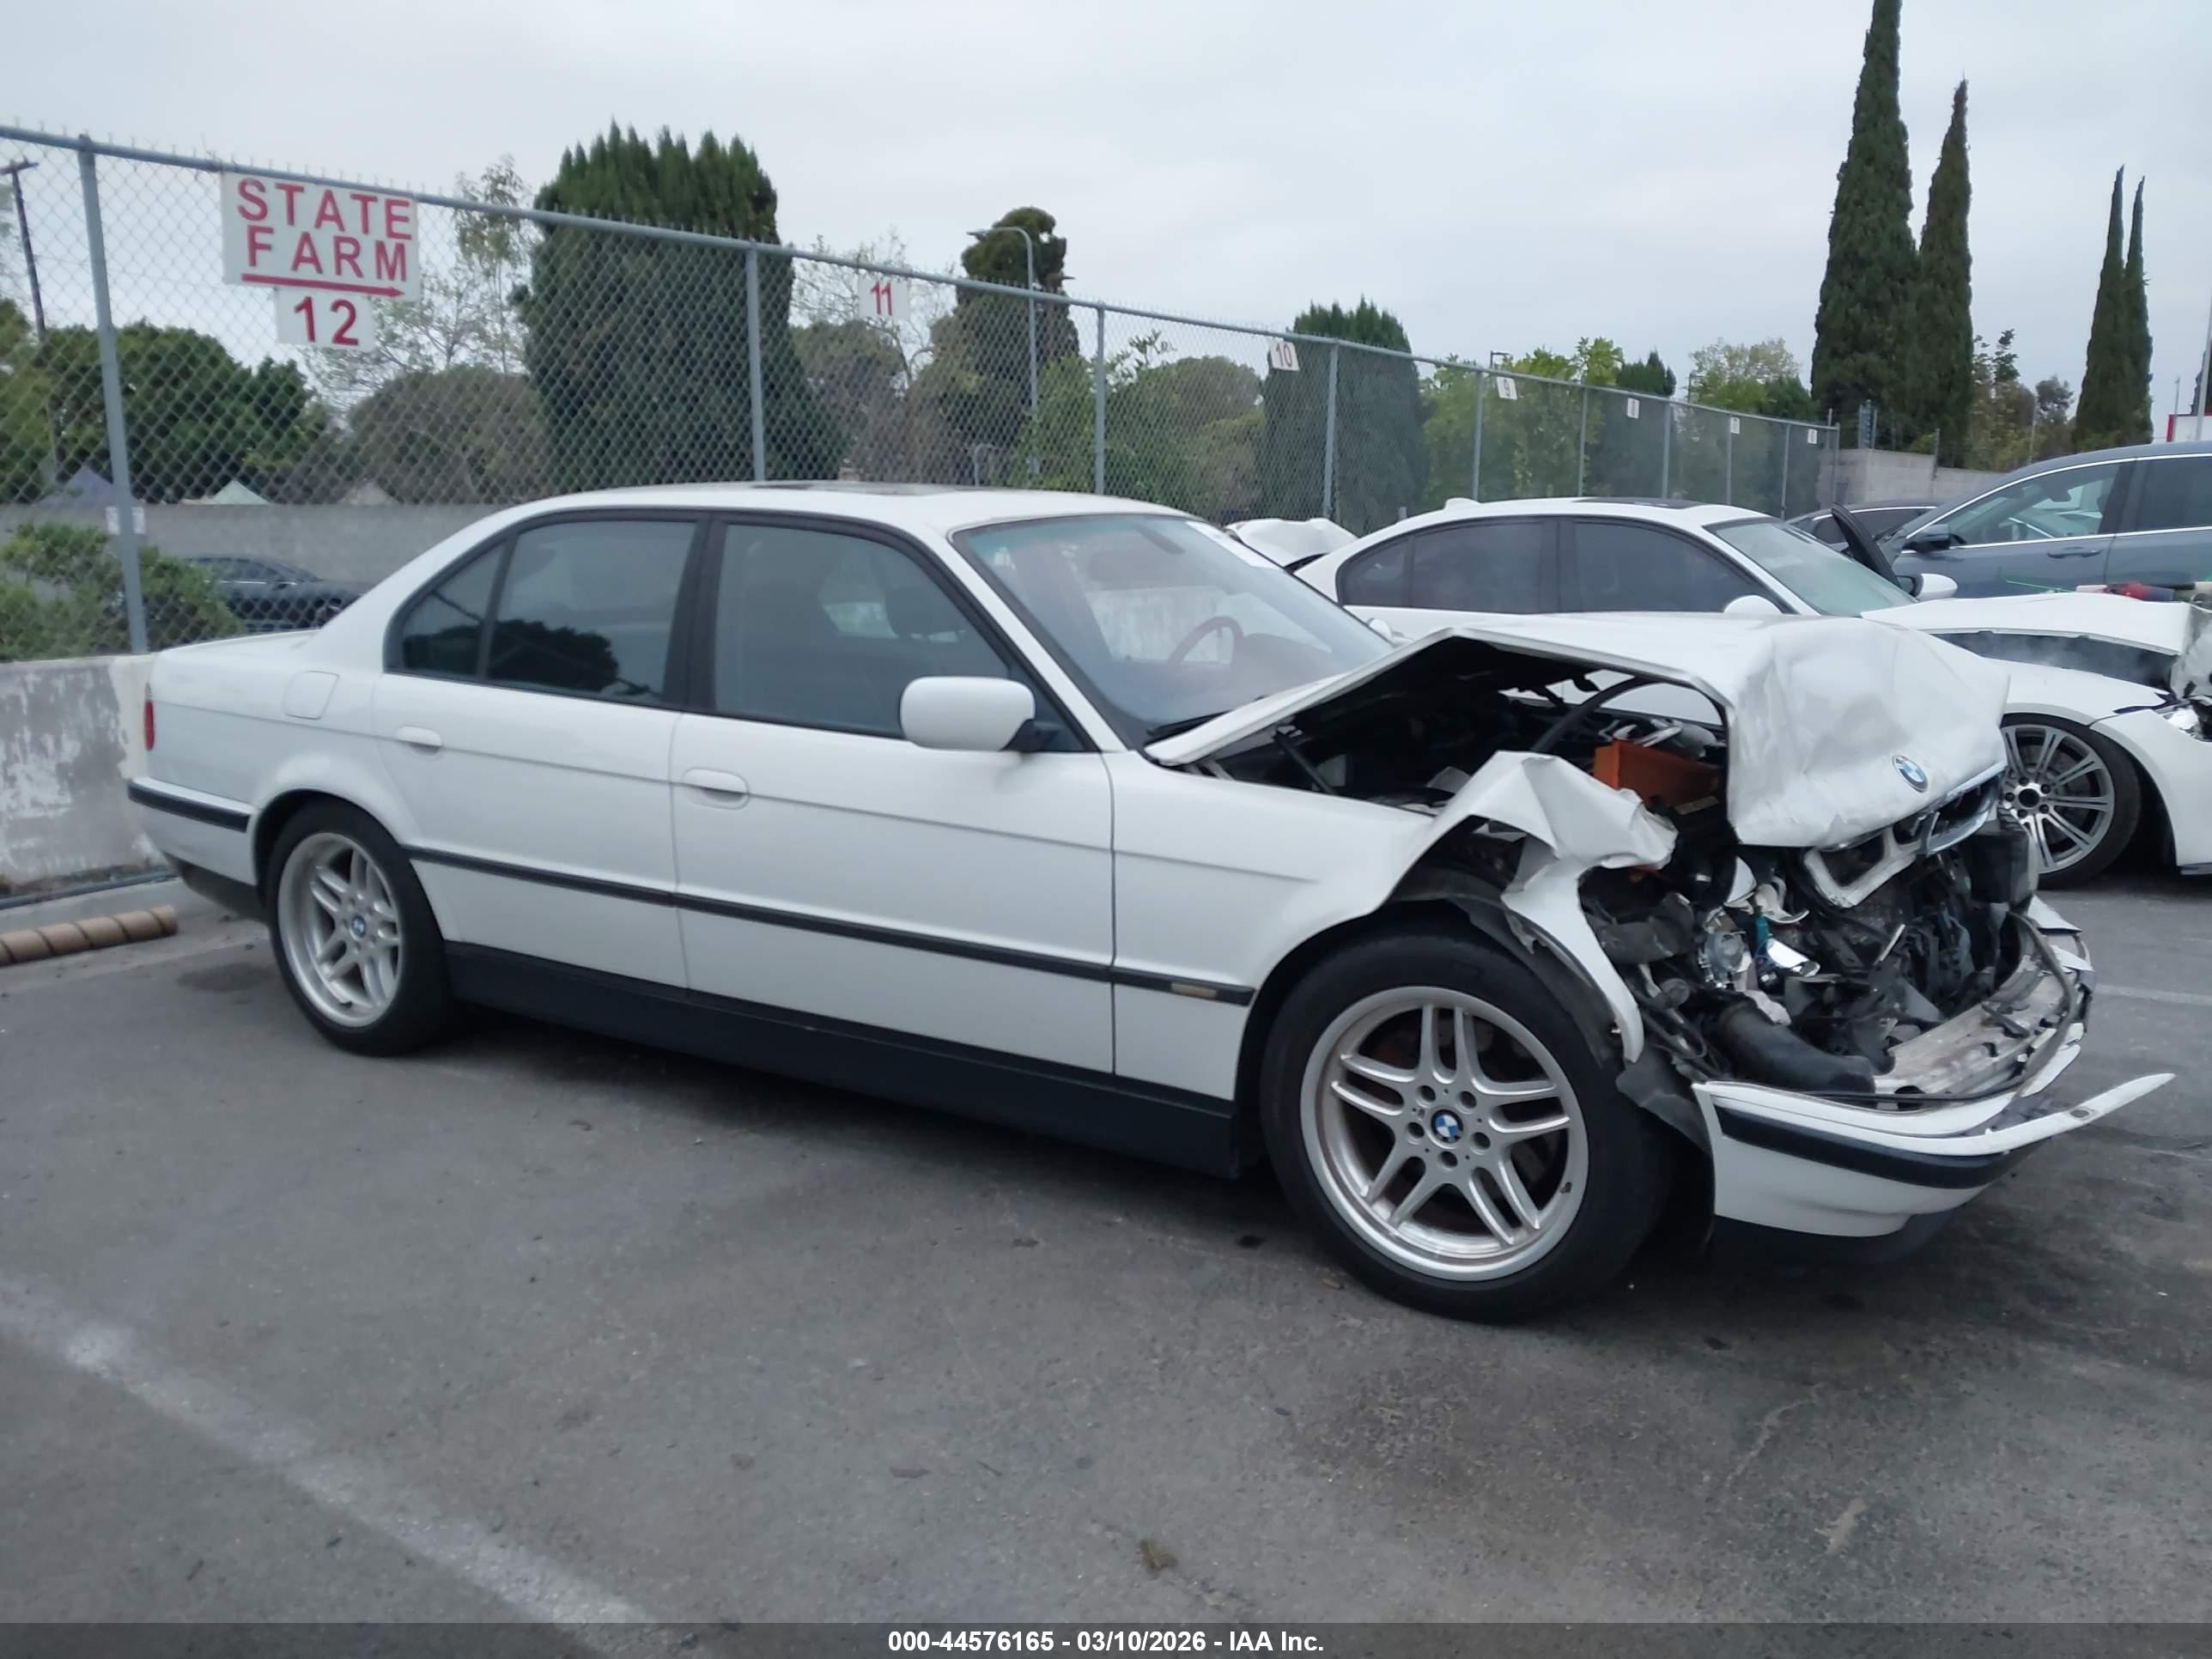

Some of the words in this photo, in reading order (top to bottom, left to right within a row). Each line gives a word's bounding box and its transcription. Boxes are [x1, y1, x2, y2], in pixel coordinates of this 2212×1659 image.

[237, 178, 412, 240] STATE
[246, 224, 407, 283] FARM
[294, 295, 359, 346] 12
[870, 281, 893, 317] 11
[1276, 343, 1292, 368] 10
